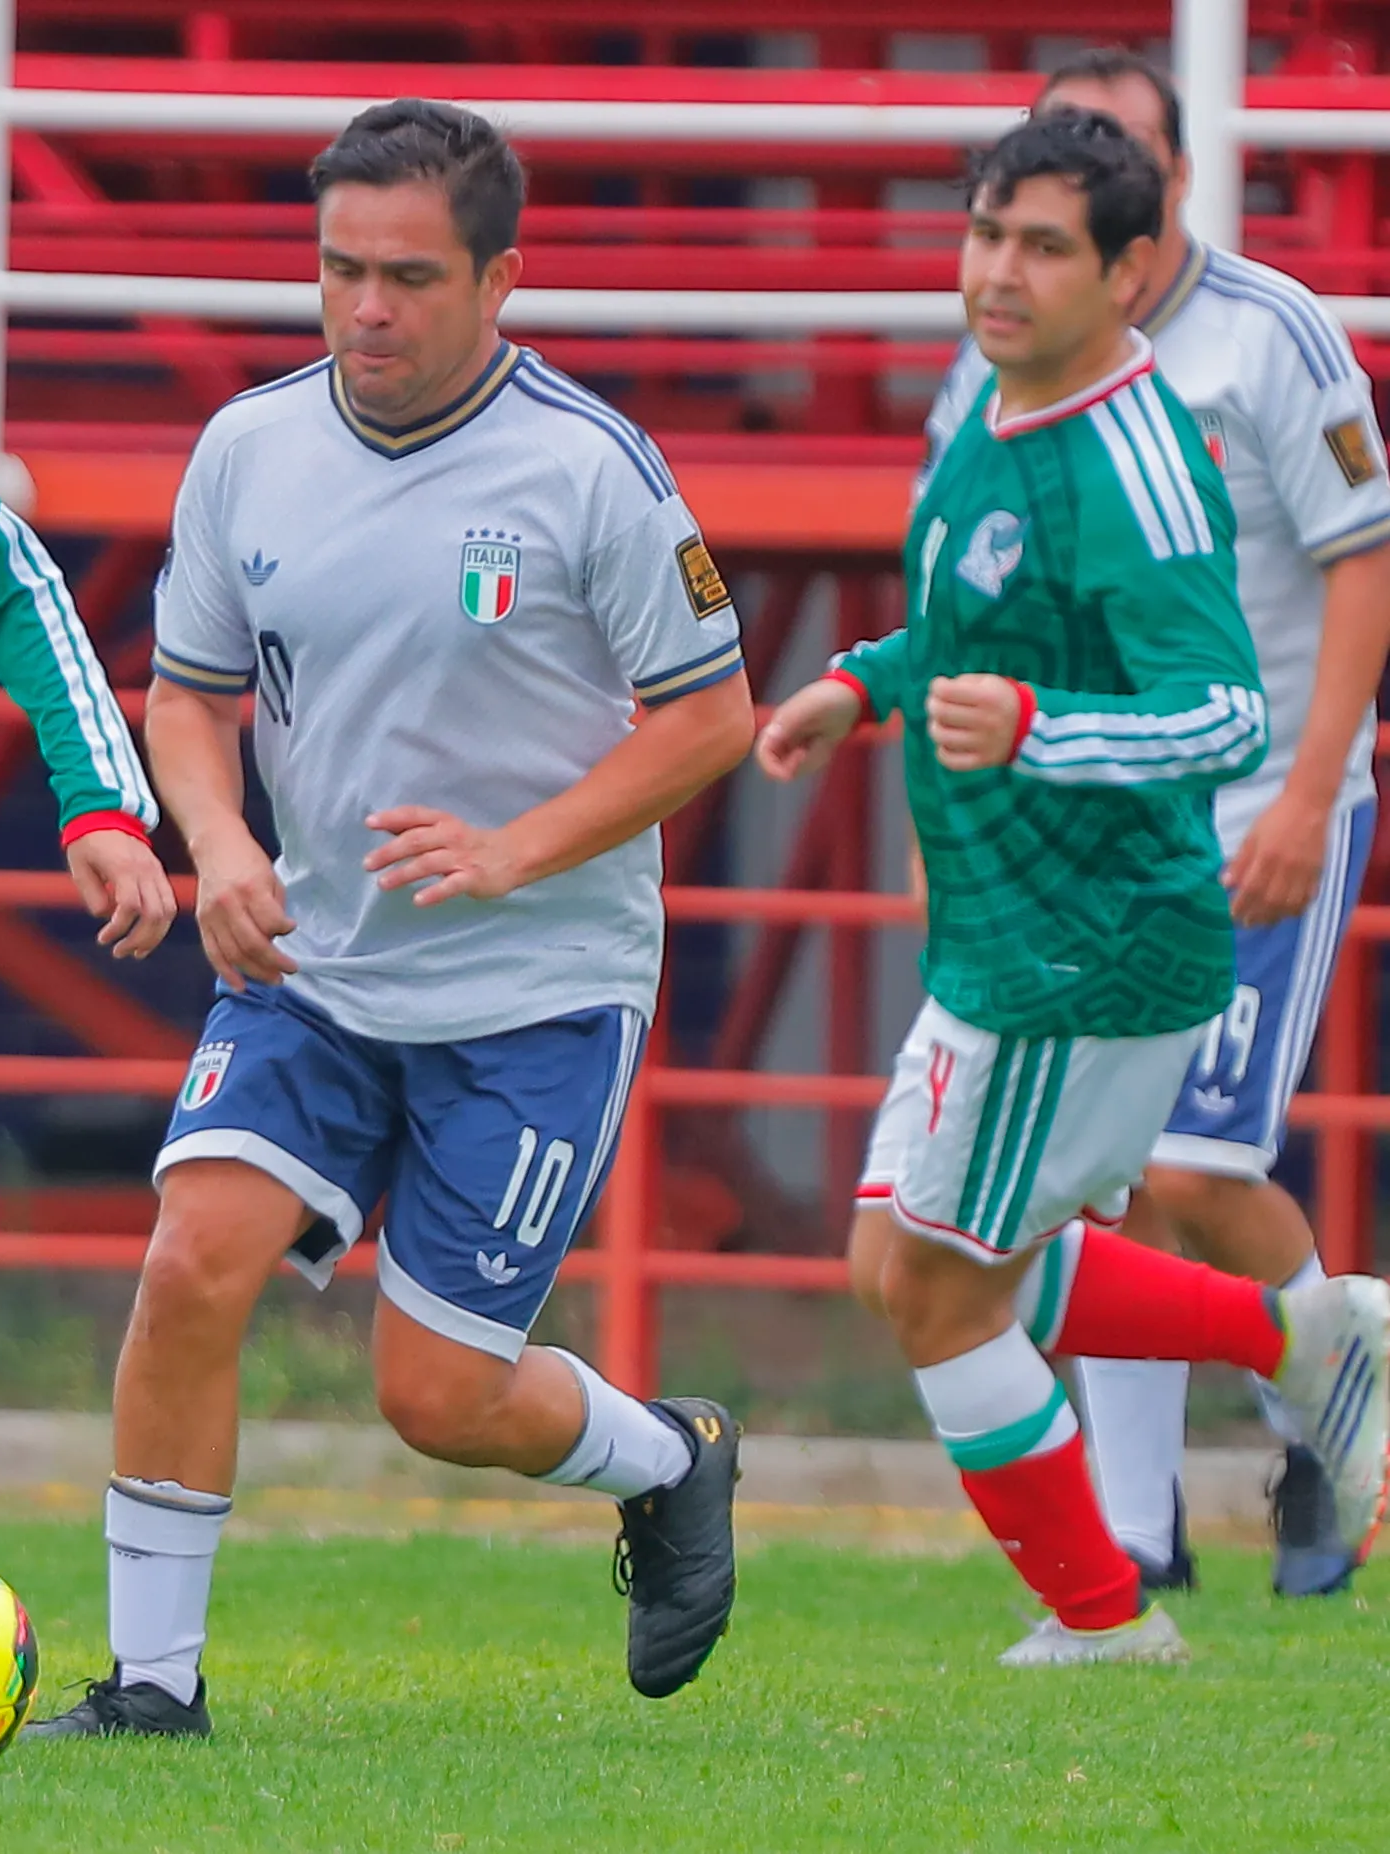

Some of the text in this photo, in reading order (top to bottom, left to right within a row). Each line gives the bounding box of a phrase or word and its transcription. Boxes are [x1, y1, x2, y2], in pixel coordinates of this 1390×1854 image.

[466, 547, 514, 566] ITALIA
[1196, 983, 1262, 1084] 19
[492, 1125, 576, 1248] 10
